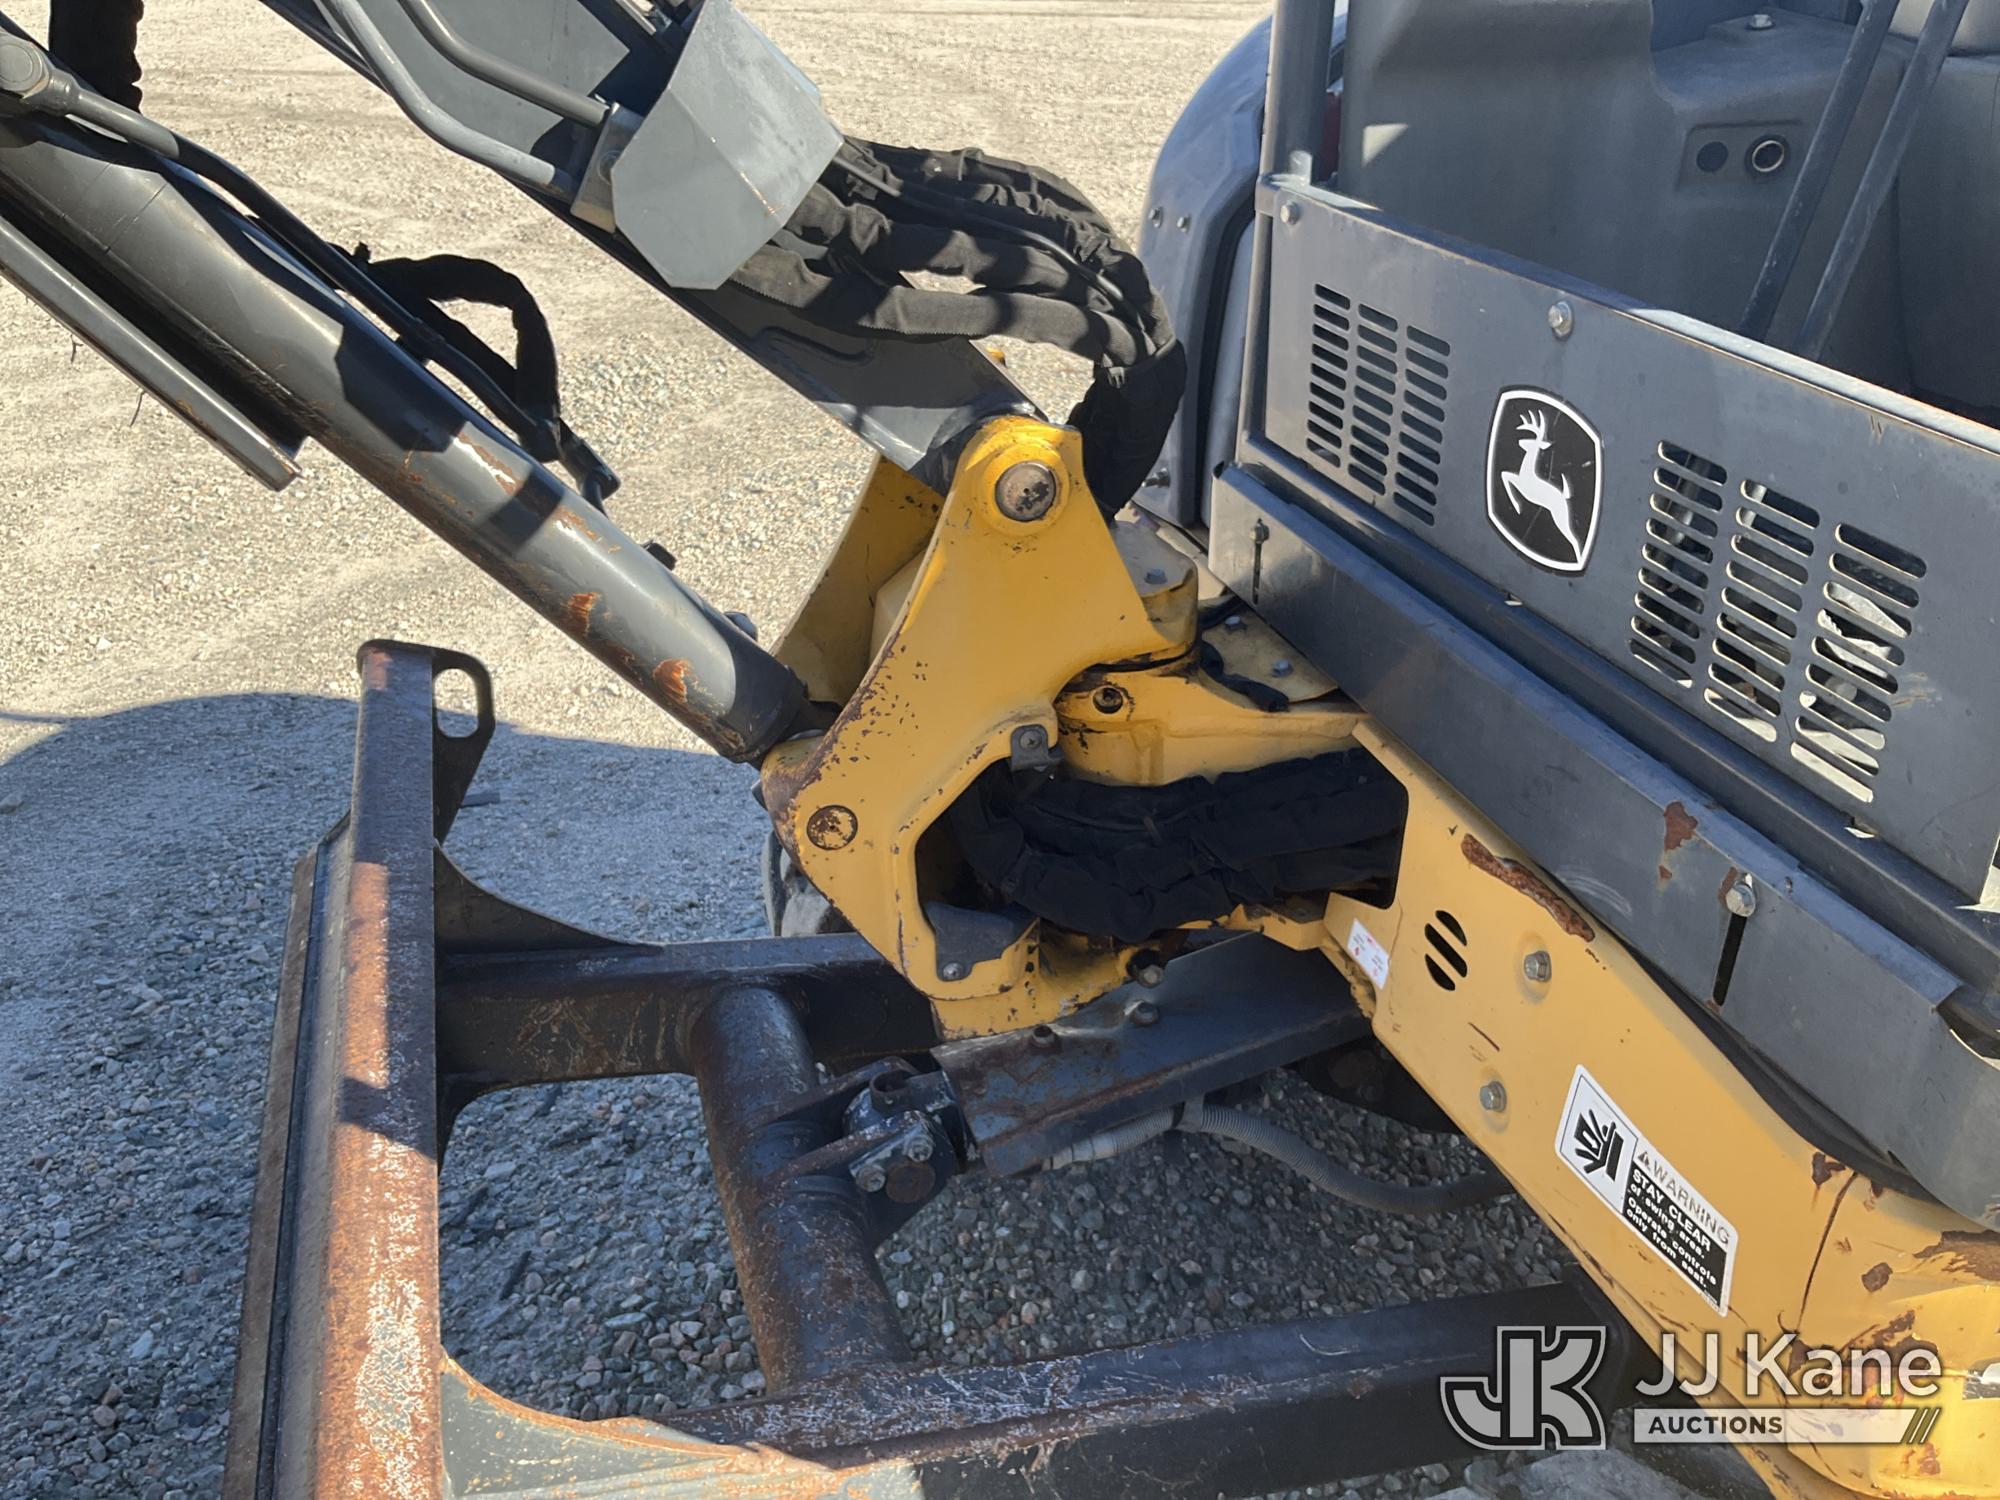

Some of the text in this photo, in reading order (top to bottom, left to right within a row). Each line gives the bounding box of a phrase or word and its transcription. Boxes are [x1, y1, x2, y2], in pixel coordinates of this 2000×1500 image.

[1628, 1197, 1717, 1285] Operate controls
[1630, 1184, 1705, 1259] of swing area.
[1633, 1168, 1711, 1251] STAY CLEAR
[1654, 1159, 1730, 1245] WARNING
[1627, 1208, 1707, 1288] only from seat.
